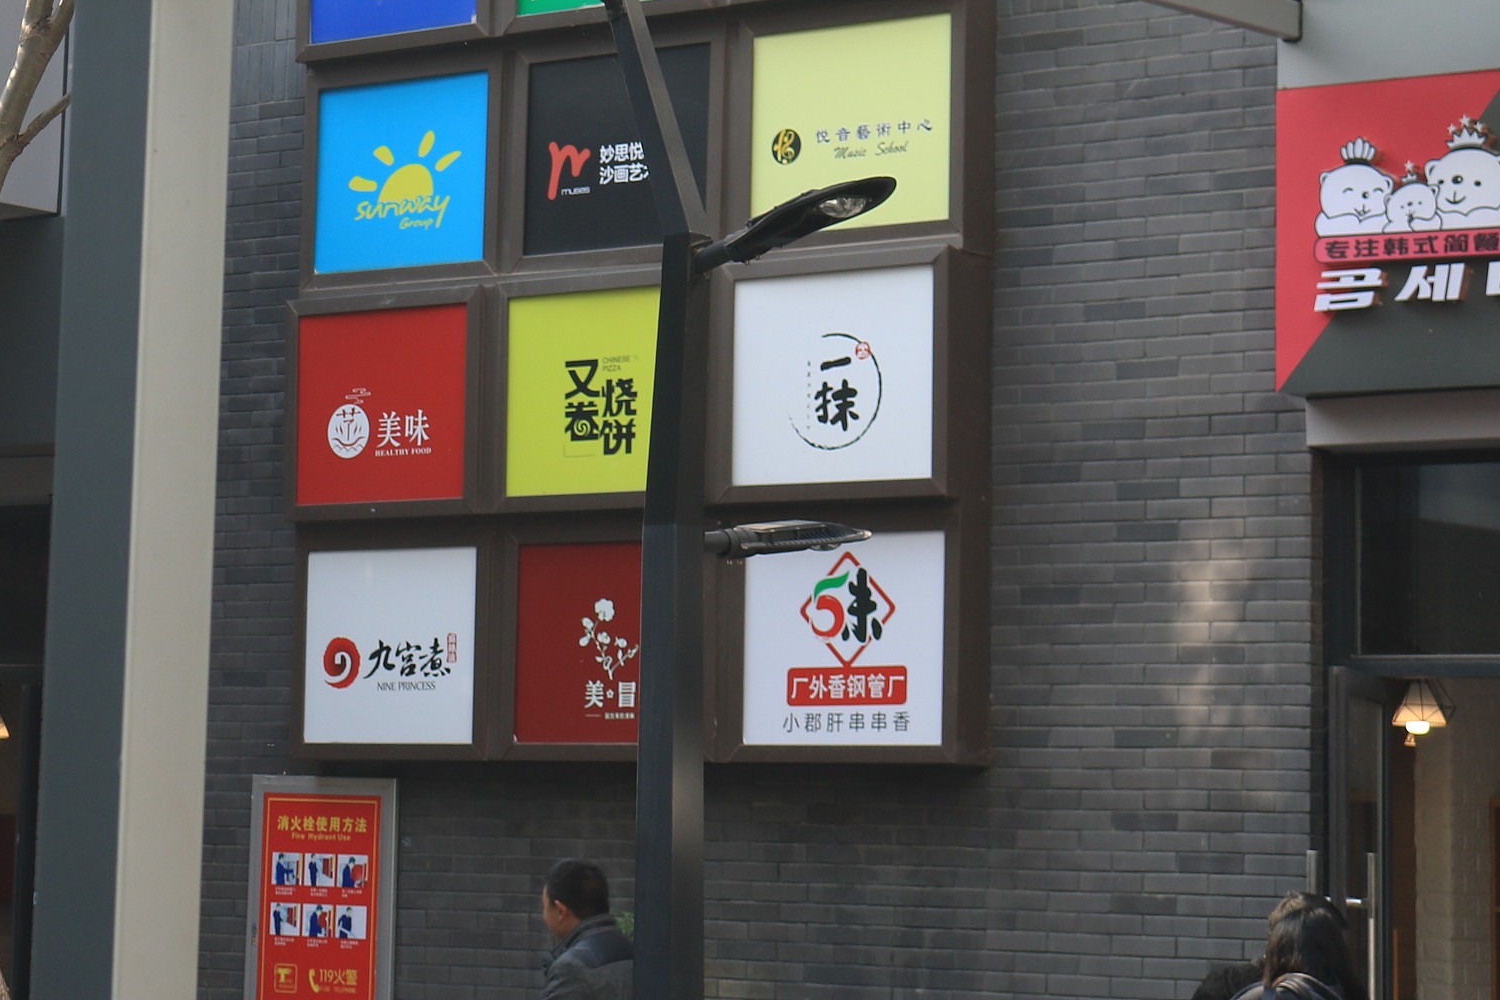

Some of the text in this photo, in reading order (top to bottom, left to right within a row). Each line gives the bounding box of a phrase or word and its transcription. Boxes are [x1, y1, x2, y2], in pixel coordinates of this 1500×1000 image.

[599, 141, 645, 164] 妙思悦
[1325, 232, 1500, 259] 专注韩式简餐
[377, 408, 430, 448] 美味
[375, 446, 432, 457] HEALTHY FOOD
[377, 681, 436, 691] NINE PRINCESS
[791, 672, 905, 699] 厂外香钢管厂
[783, 711, 910, 733] 小郡肝串串香
[277, 815, 367, 834] 消火栓使用方法
